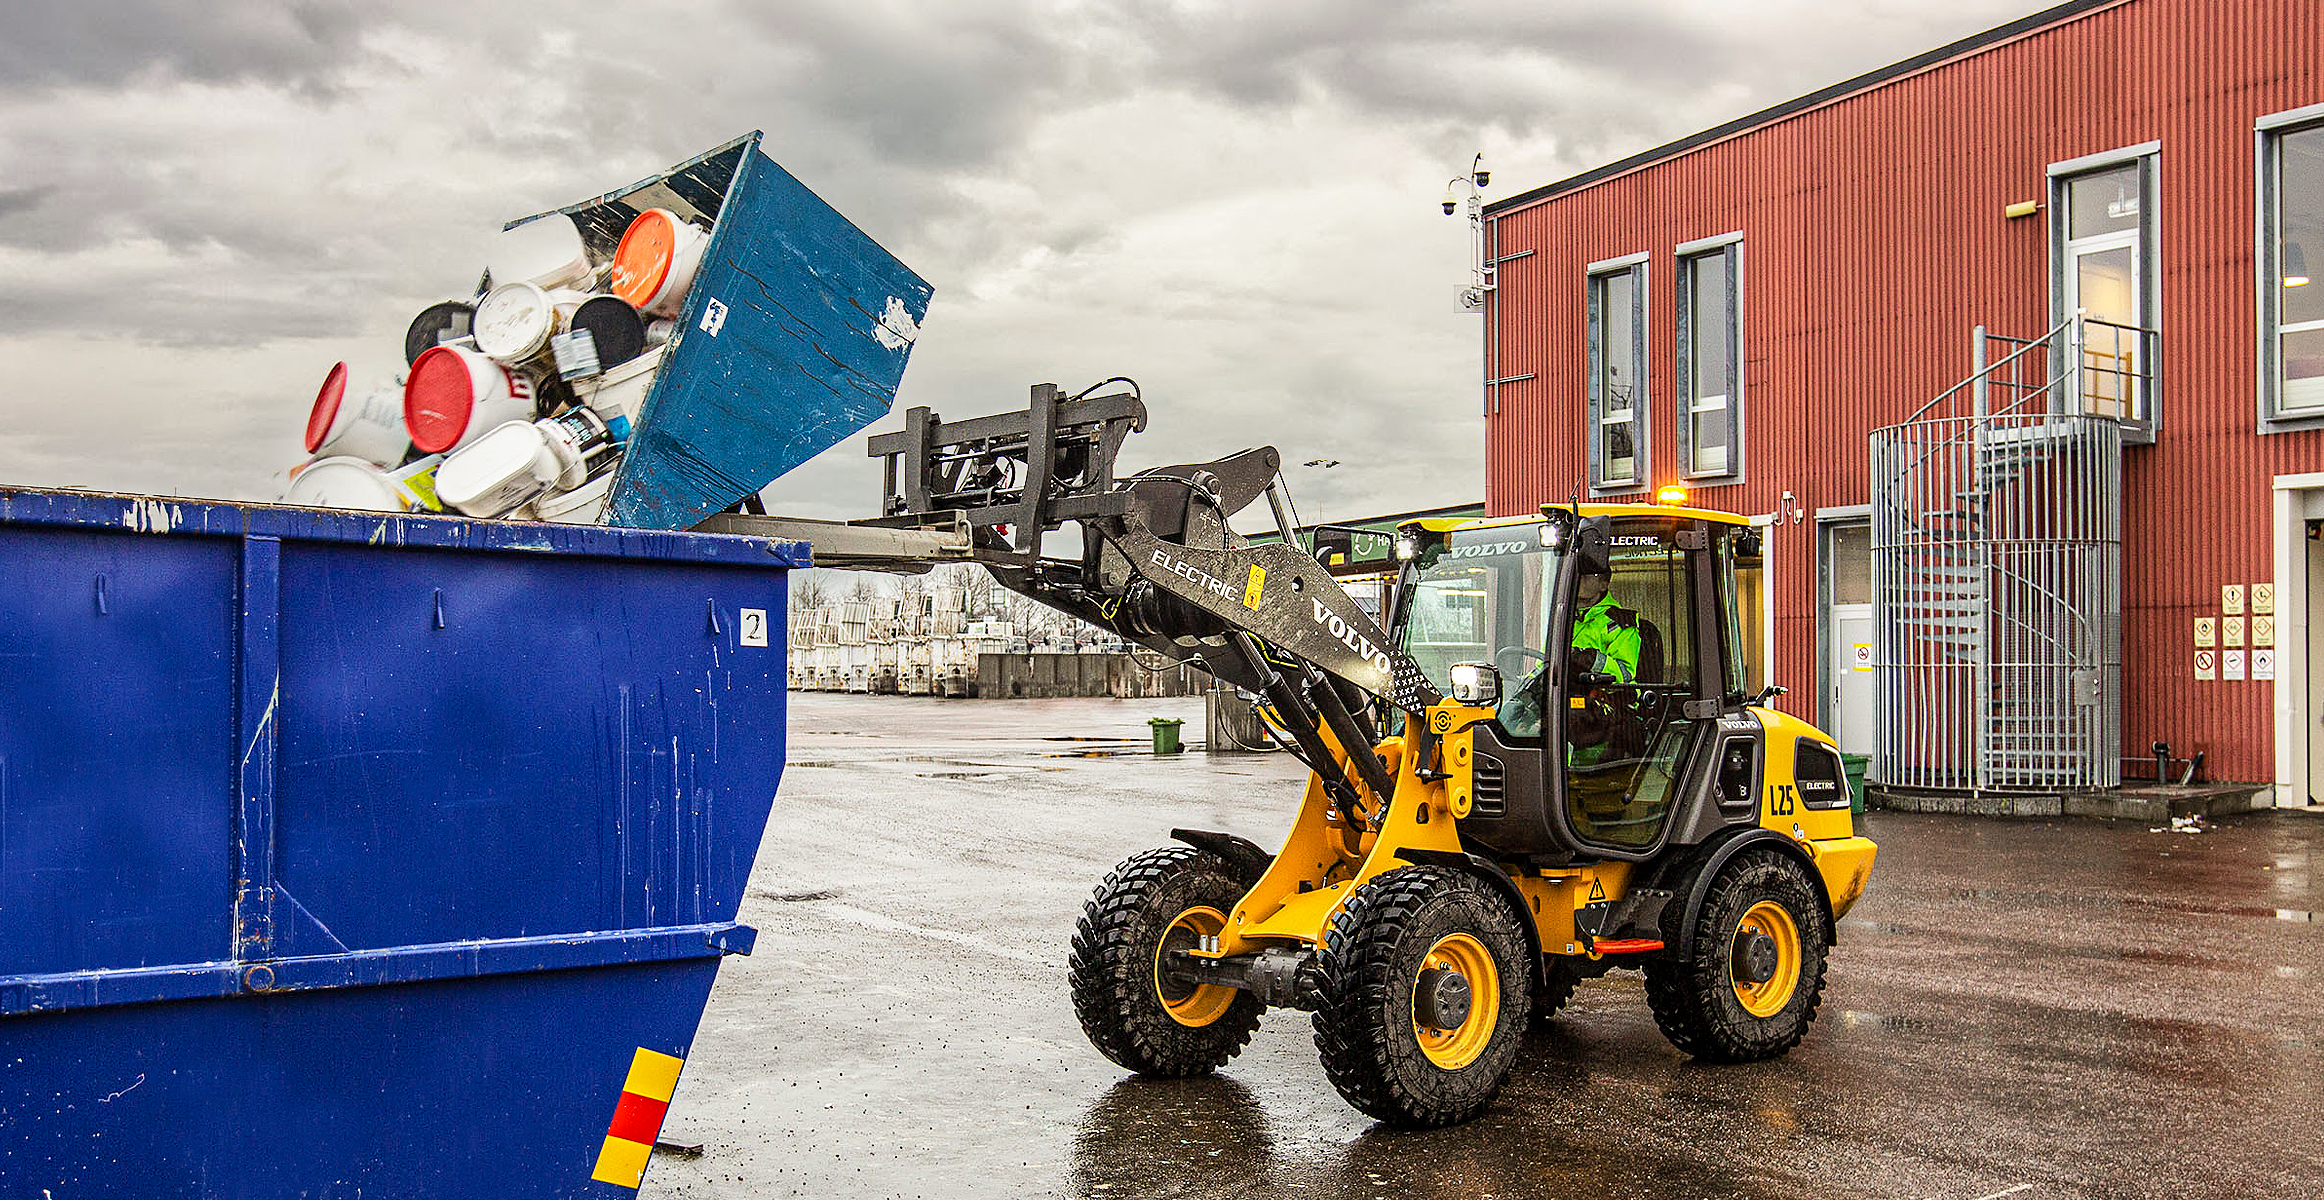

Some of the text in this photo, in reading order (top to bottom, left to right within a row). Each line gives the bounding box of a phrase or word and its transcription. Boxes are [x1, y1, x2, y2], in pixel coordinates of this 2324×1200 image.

[1450, 541, 1527, 559] VOLVO
[1152, 549, 1239, 601] ELECTRIC
[746, 613, 761, 639] 2
[1311, 596, 1391, 674] VOLVO
[1722, 721, 1758, 729] VOLVO
[1806, 782, 1835, 790] ELECTRIC
[1770, 785, 1794, 816] L25
